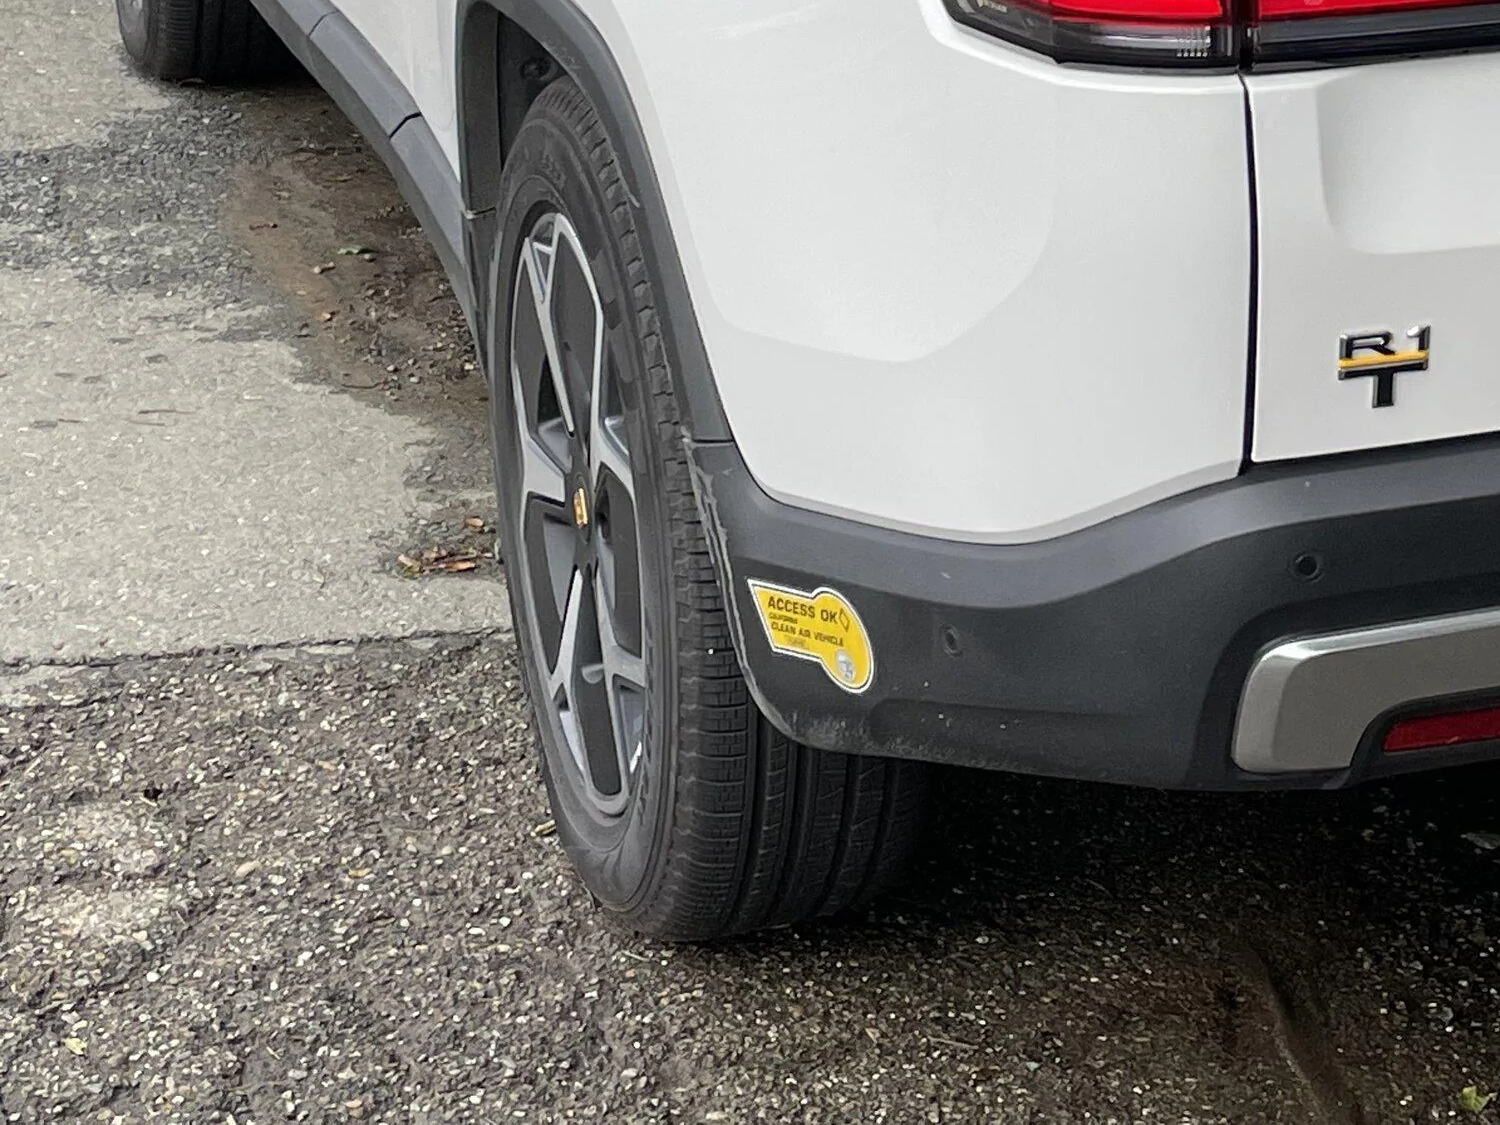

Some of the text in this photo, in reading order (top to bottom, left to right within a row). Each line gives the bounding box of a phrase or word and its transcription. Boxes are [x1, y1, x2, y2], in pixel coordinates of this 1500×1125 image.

[768, 596, 838, 625] ACCESS OK
[771, 621, 796, 635] CLEAN
[799, 629, 811, 638] AIR
